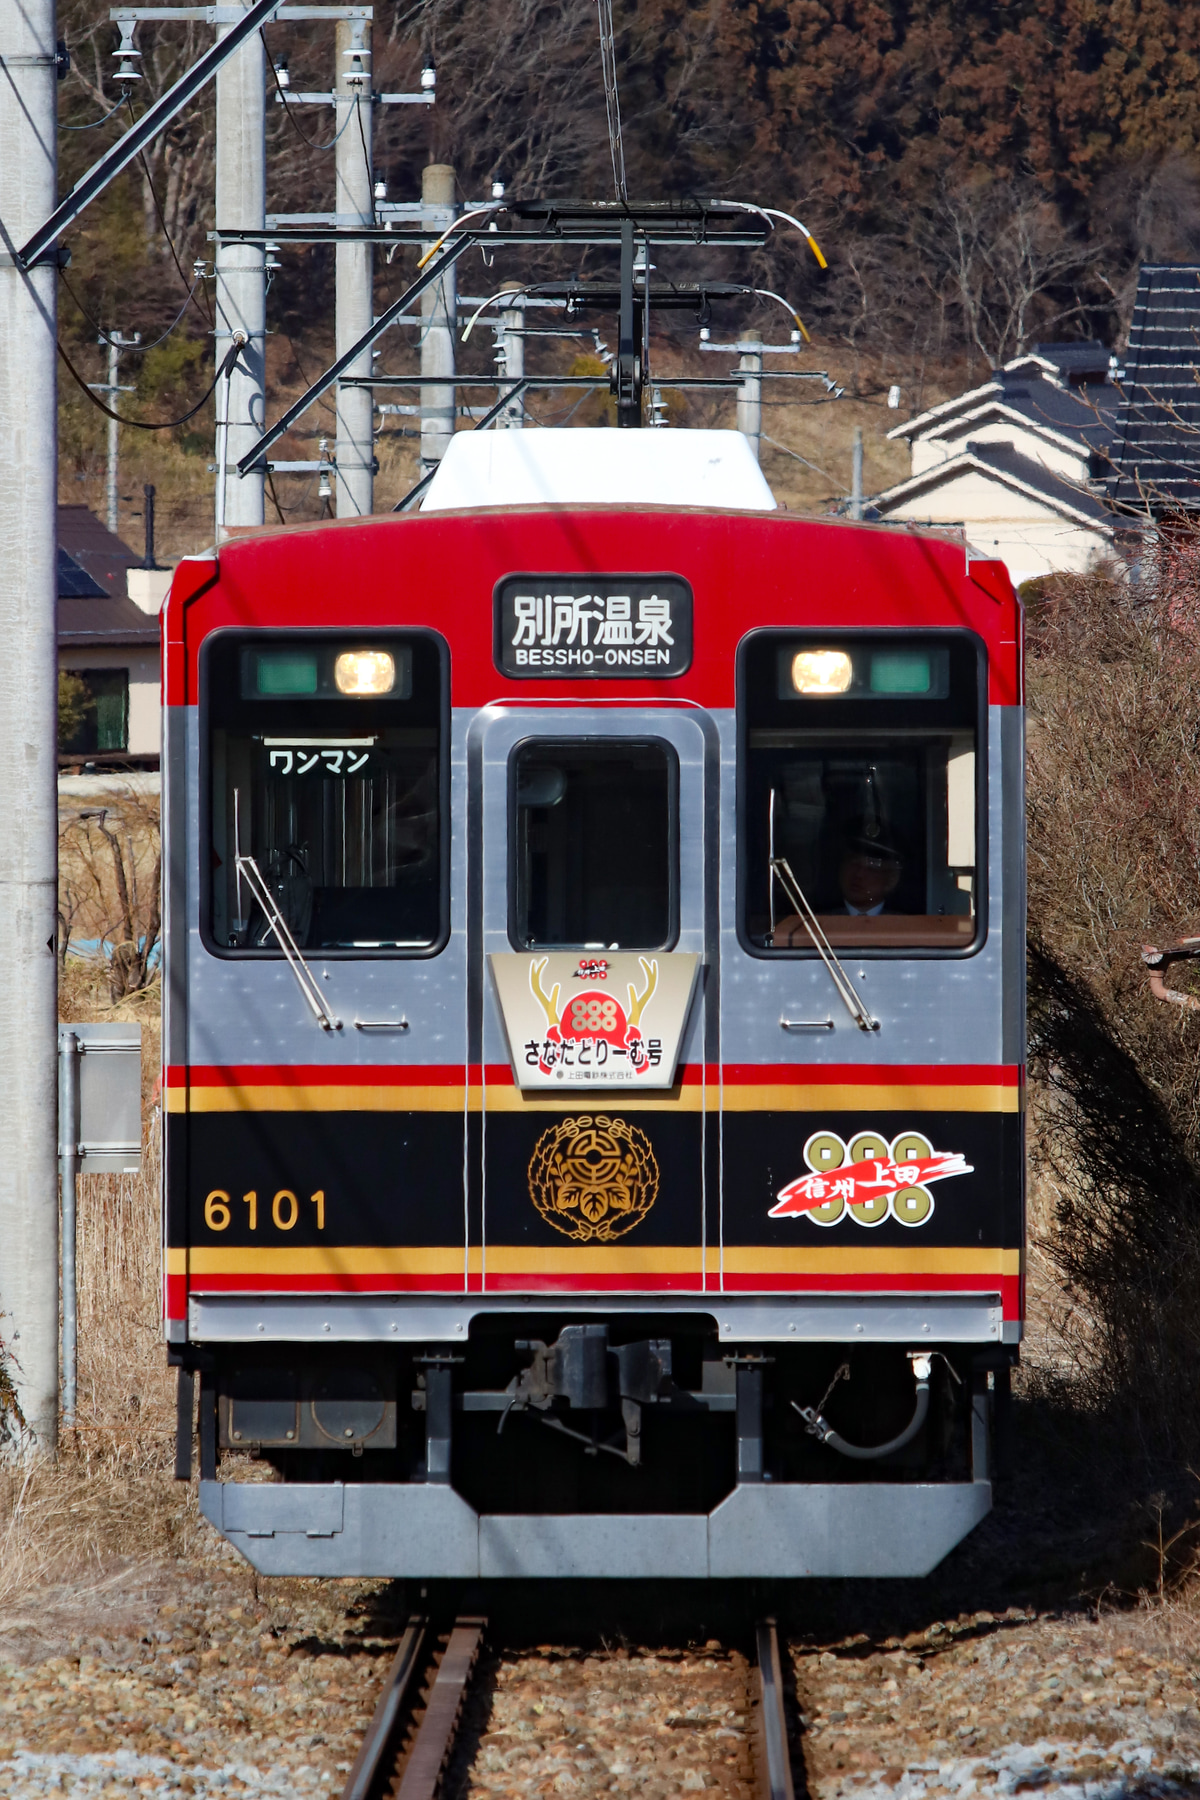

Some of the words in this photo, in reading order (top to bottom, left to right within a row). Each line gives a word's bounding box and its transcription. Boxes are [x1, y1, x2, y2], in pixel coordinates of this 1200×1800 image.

[512, 594, 675, 646] 別所温泉
[515, 649, 670, 665] BESSHO-ONSEN
[269, 750, 370, 775] ワンマン
[524, 1039, 663, 1066] さなだどりーむ号
[204, 1189, 325, 1231] 6101
